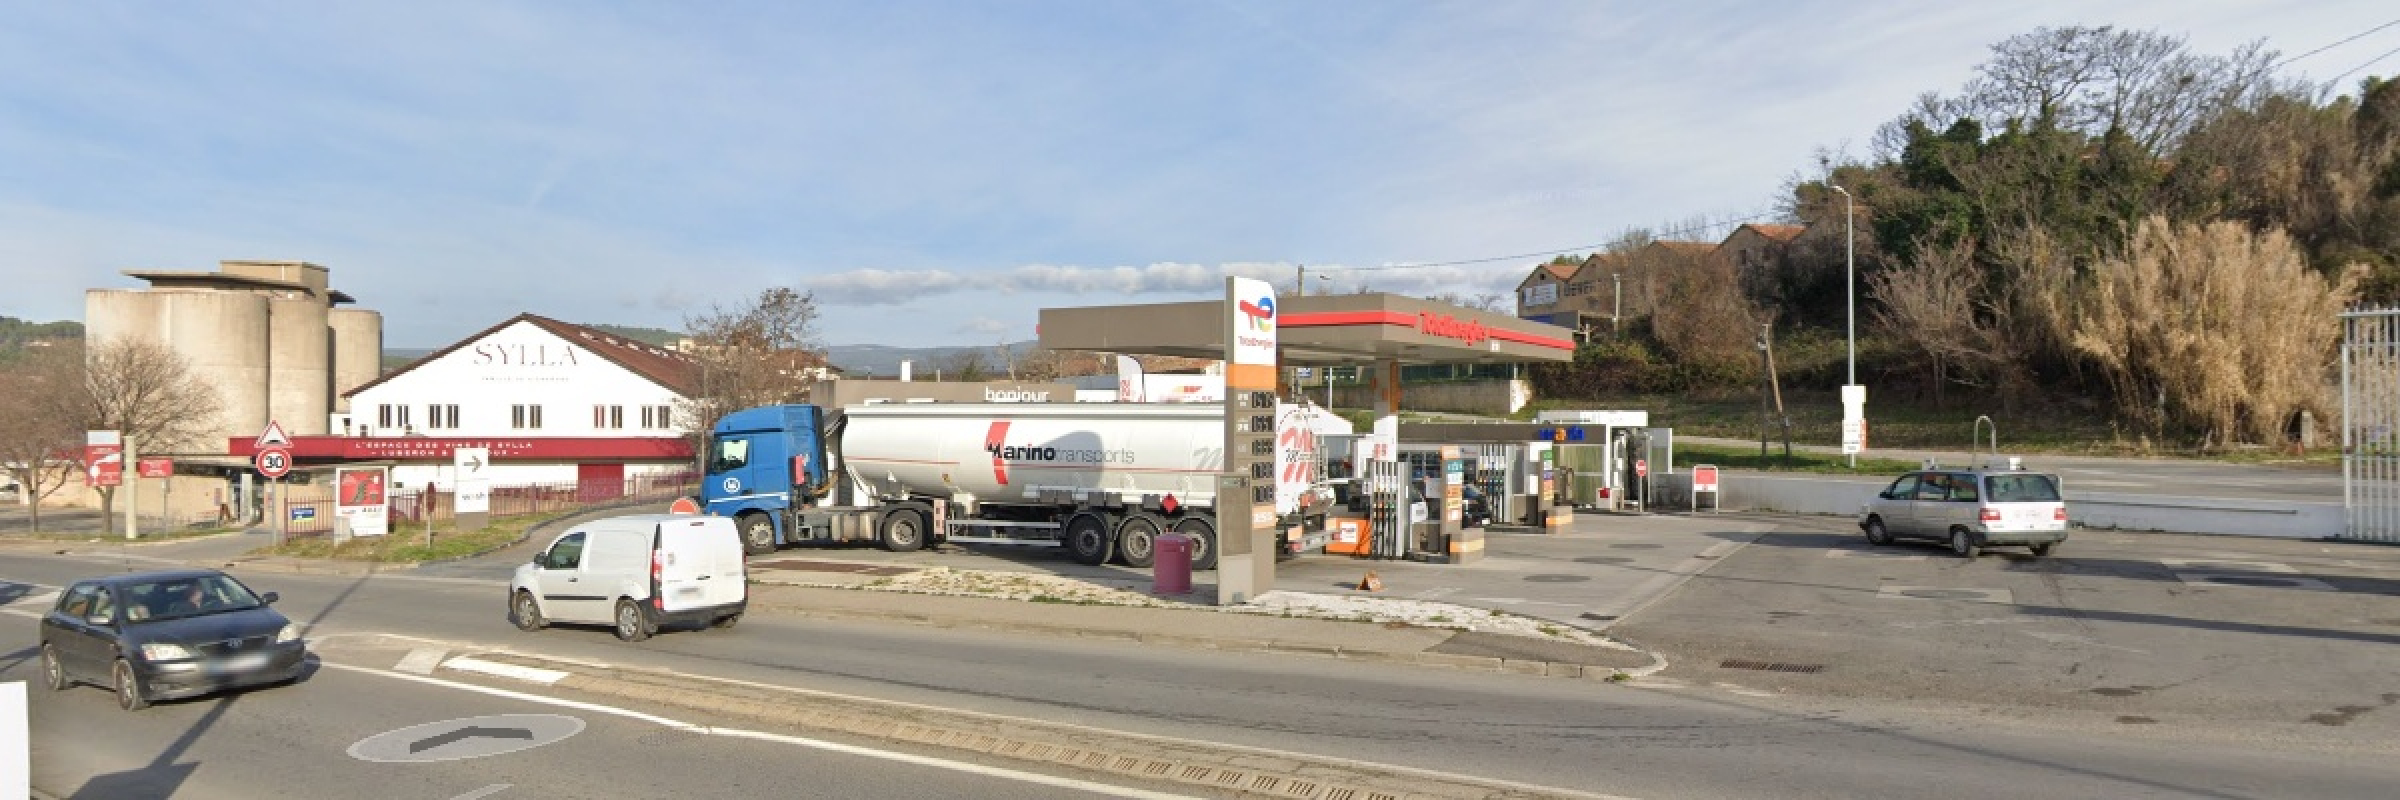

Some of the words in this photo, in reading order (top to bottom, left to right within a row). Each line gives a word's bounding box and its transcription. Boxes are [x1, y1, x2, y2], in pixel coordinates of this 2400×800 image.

[473, 343, 578, 366] SYLLA
[985, 386, 1050, 402] bonjour
[265, 456, 283, 468] 30
